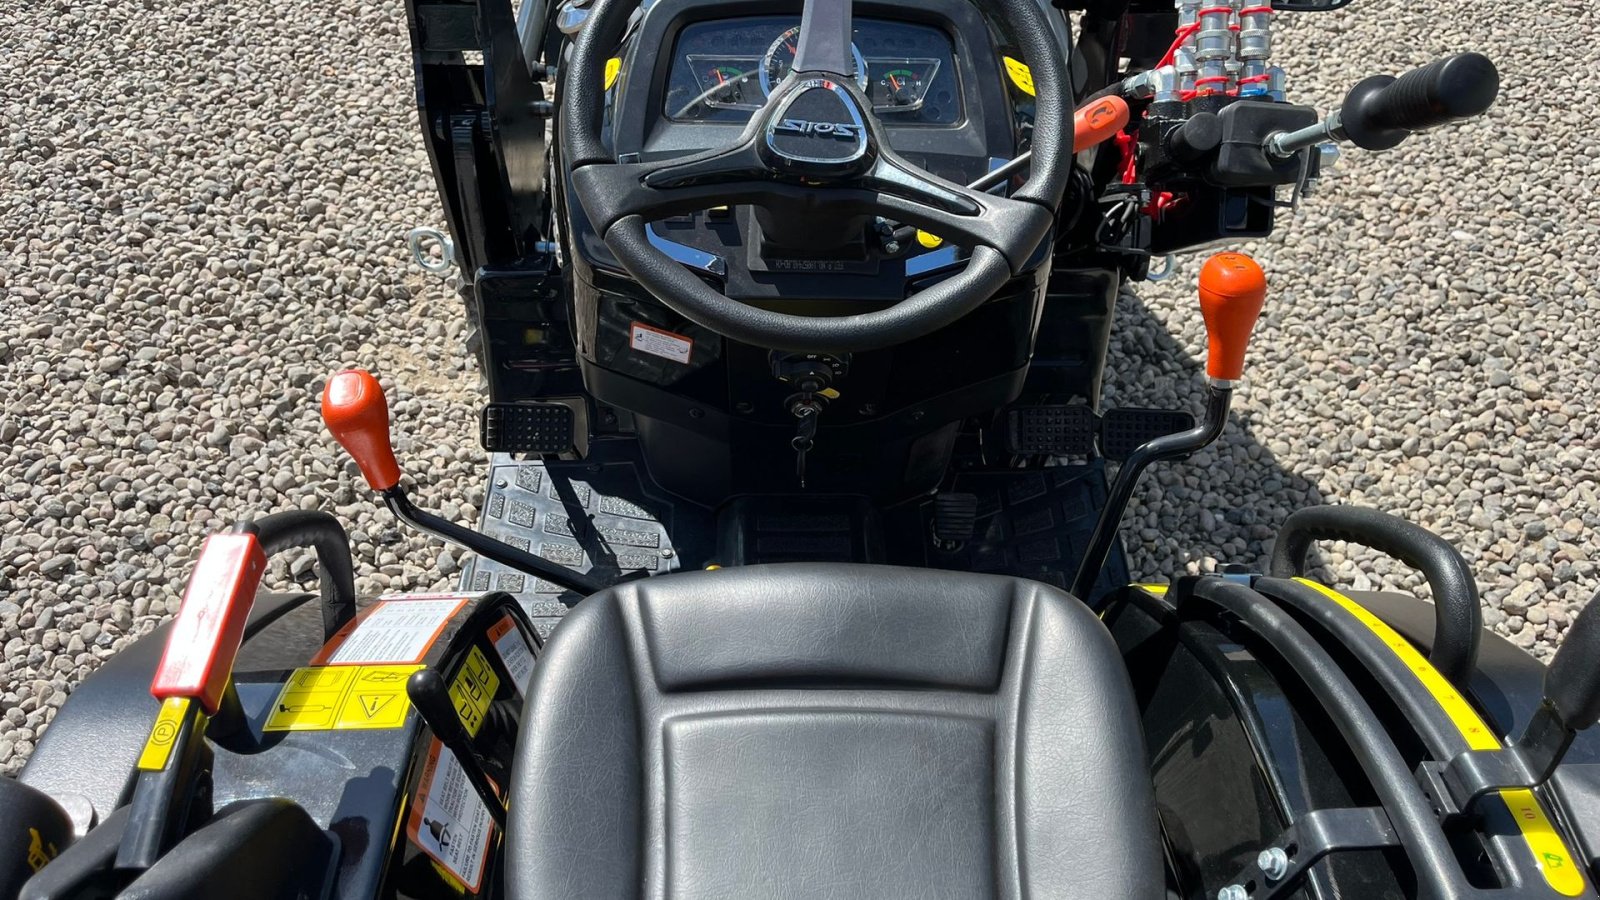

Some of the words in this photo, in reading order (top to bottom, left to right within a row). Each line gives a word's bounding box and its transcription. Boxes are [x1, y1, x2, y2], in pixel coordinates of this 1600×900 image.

[423, 754, 437, 790] WARNING
[1521, 808, 1537, 820] 10
[448, 832, 458, 857] FASTEN
[461, 853, 470, 878] FAILURE
[469, 822, 477, 846] FASTEN
[465, 858, 474, 882] RESULT
[472, 827, 481, 853] SERIOUS
